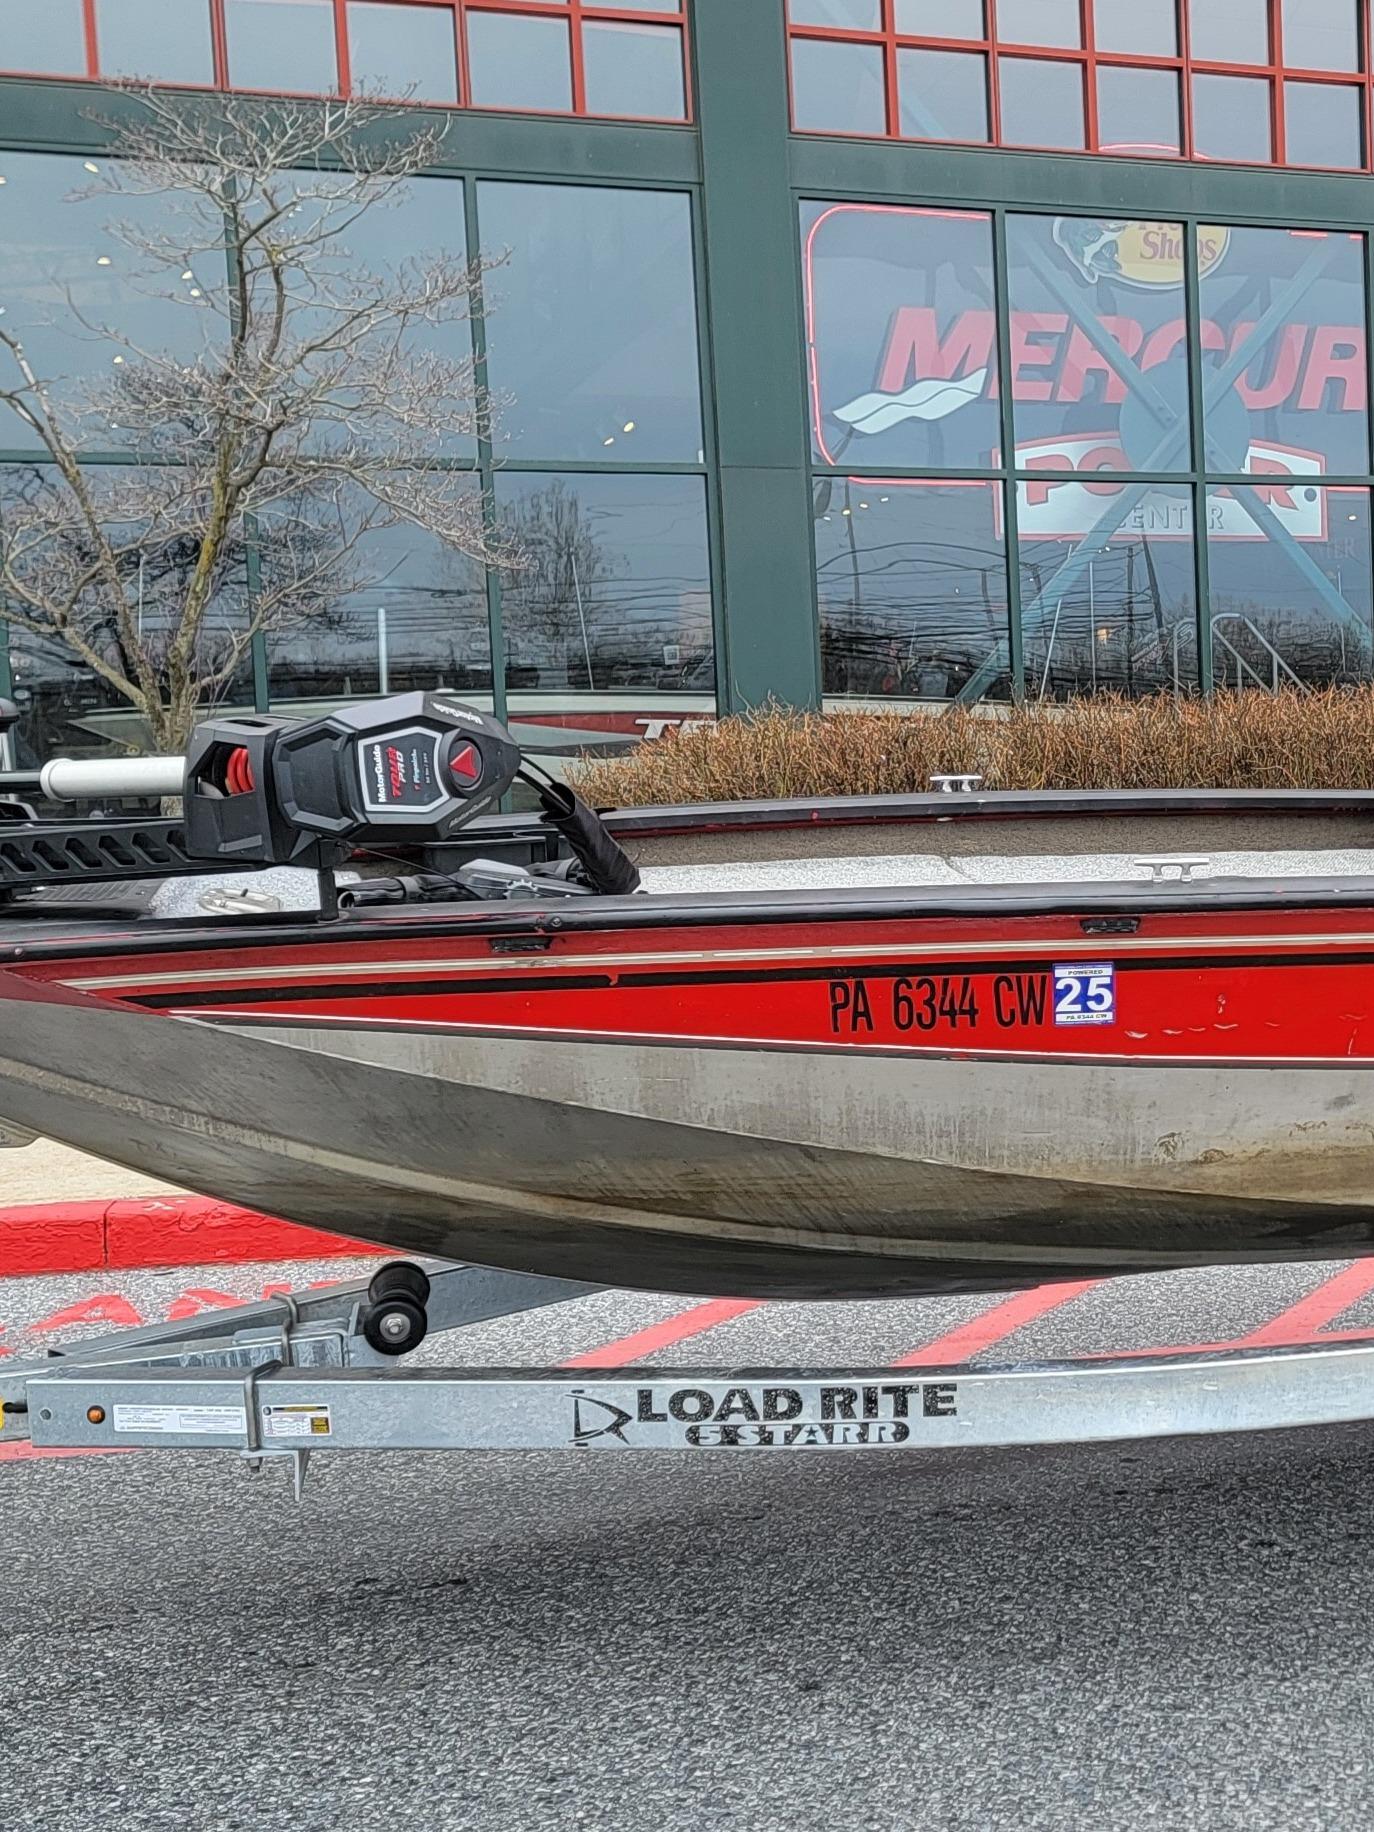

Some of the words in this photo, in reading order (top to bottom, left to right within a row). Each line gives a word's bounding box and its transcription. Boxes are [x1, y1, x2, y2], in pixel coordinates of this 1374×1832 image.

[1025, 447, 1300, 510] POR
[1117, 504, 1224, 531] ENTR
[373, 744, 386, 802] MotorGuide
[829, 979, 874, 1032] PA
[892, 977, 979, 1030] 6344
[993, 975, 1048, 1028] CW
[1055, 976, 1112, 1012] 25
[637, 1387, 803, 1422] LOAD
[820, 1383, 958, 1419] RITE
[697, 1424, 724, 1446] 5
